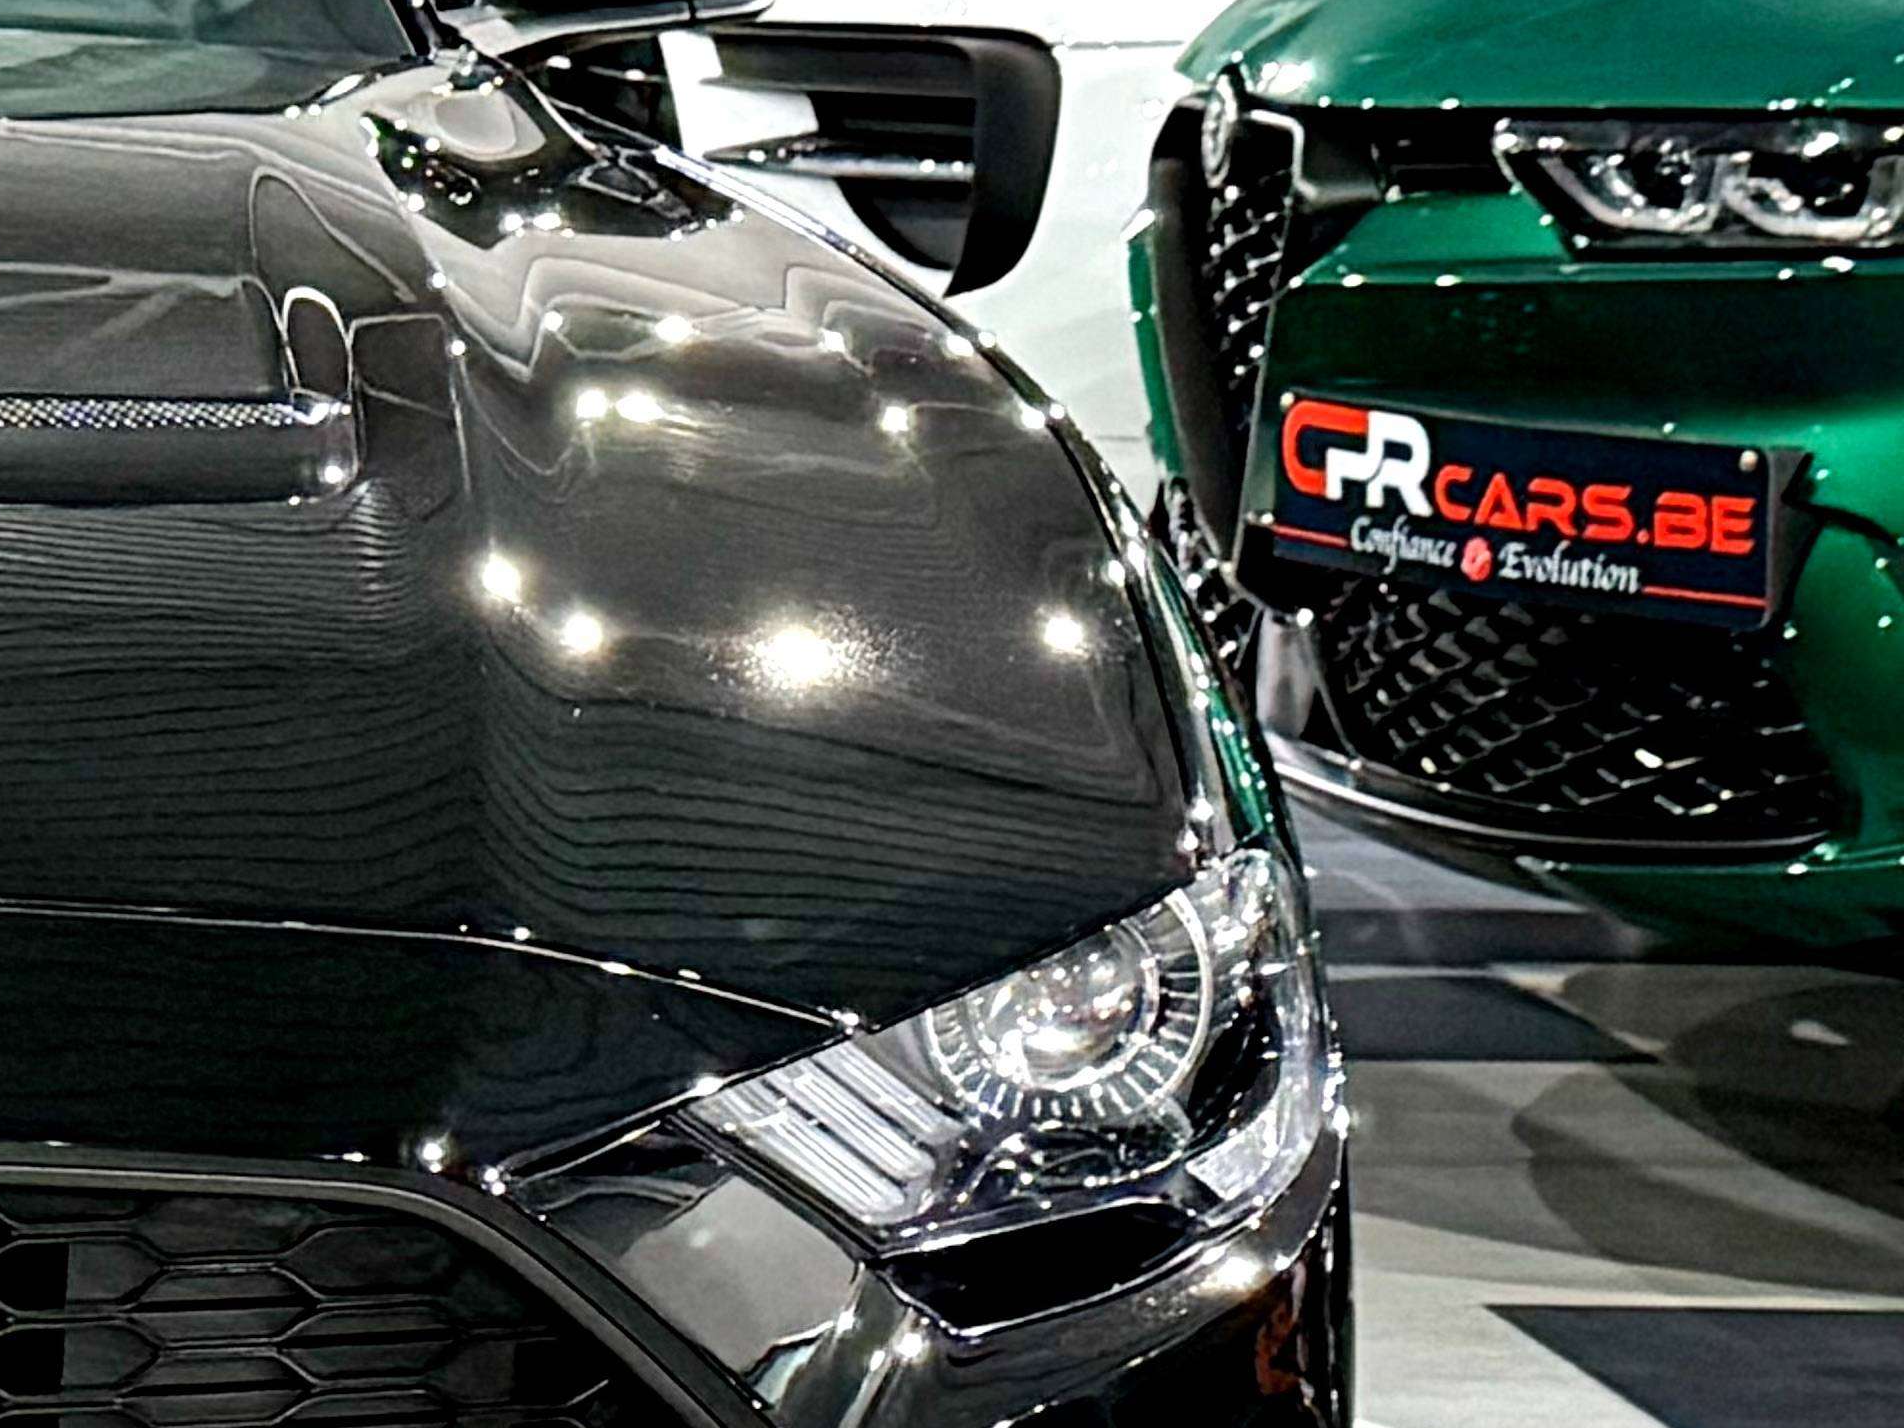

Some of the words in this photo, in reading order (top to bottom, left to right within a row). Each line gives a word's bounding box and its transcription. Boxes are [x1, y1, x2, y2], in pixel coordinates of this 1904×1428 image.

[1282, 400, 1434, 517] CPR
[1434, 464, 1756, 556] CARS.BE
[1349, 514, 1456, 574] Confiance
[1497, 538, 1641, 594] Evolution
